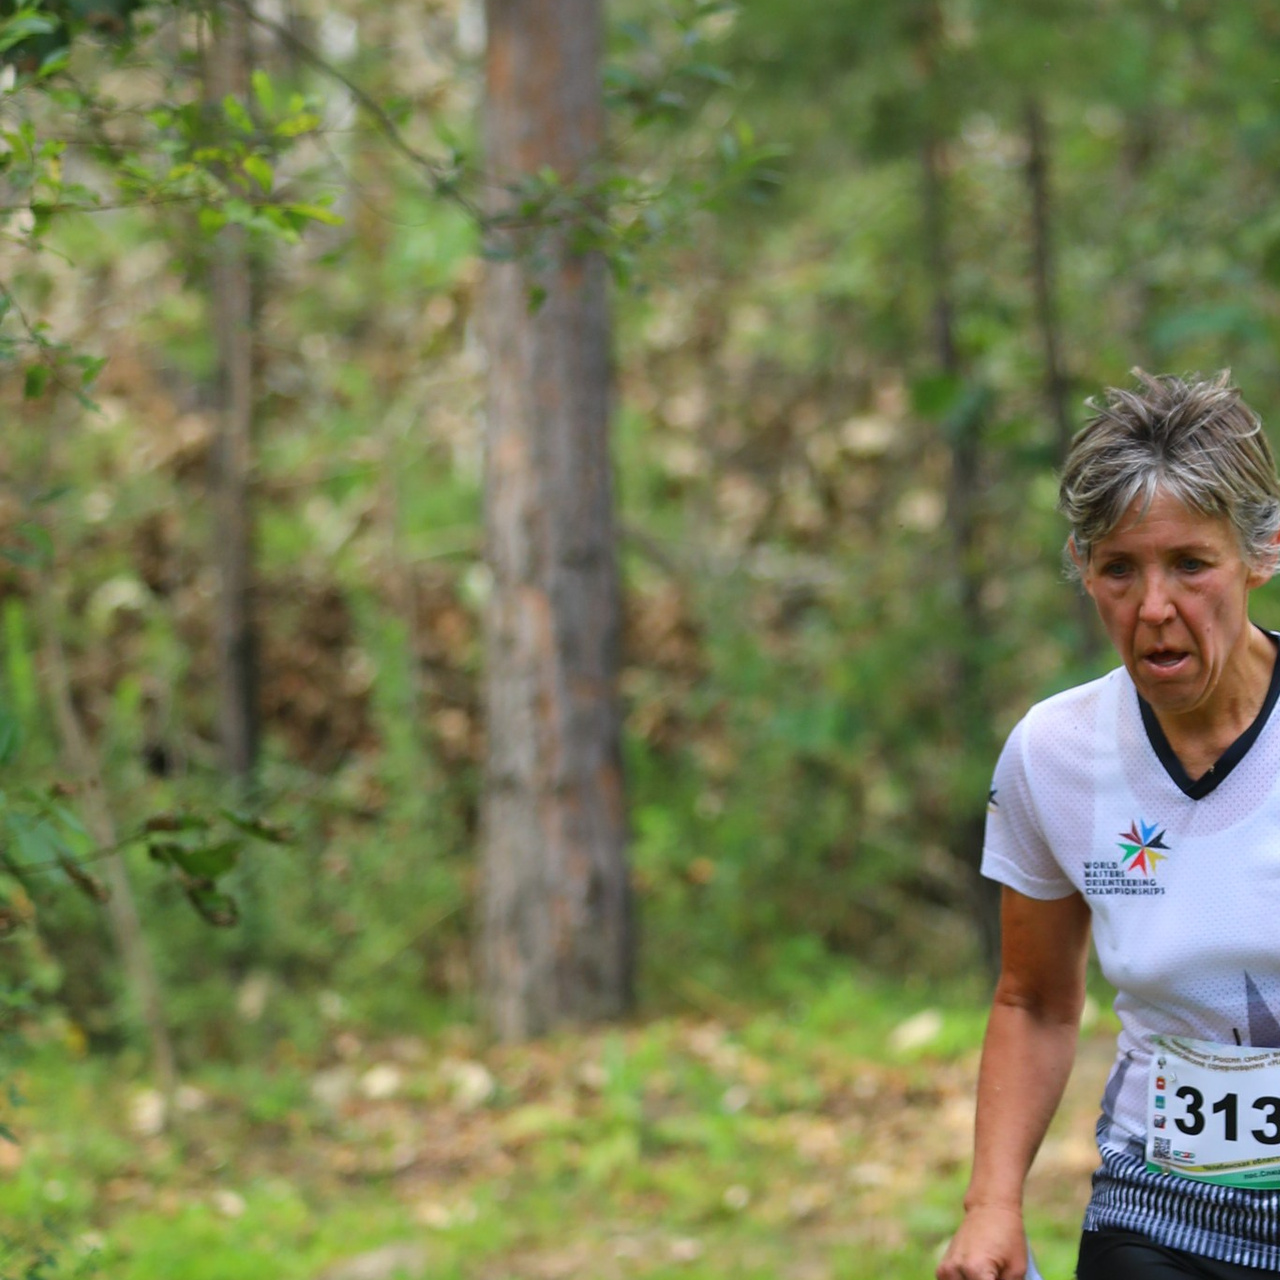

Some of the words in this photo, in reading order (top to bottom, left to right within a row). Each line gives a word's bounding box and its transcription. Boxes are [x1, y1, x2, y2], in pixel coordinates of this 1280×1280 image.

[1083, 861, 1118, 869] WORLD
[1084, 870, 1125, 878] MASTERS
[1085, 879, 1157, 887] ORIENTEERING
[1085, 887, 1166, 896] CHAMPIONSHIPS
